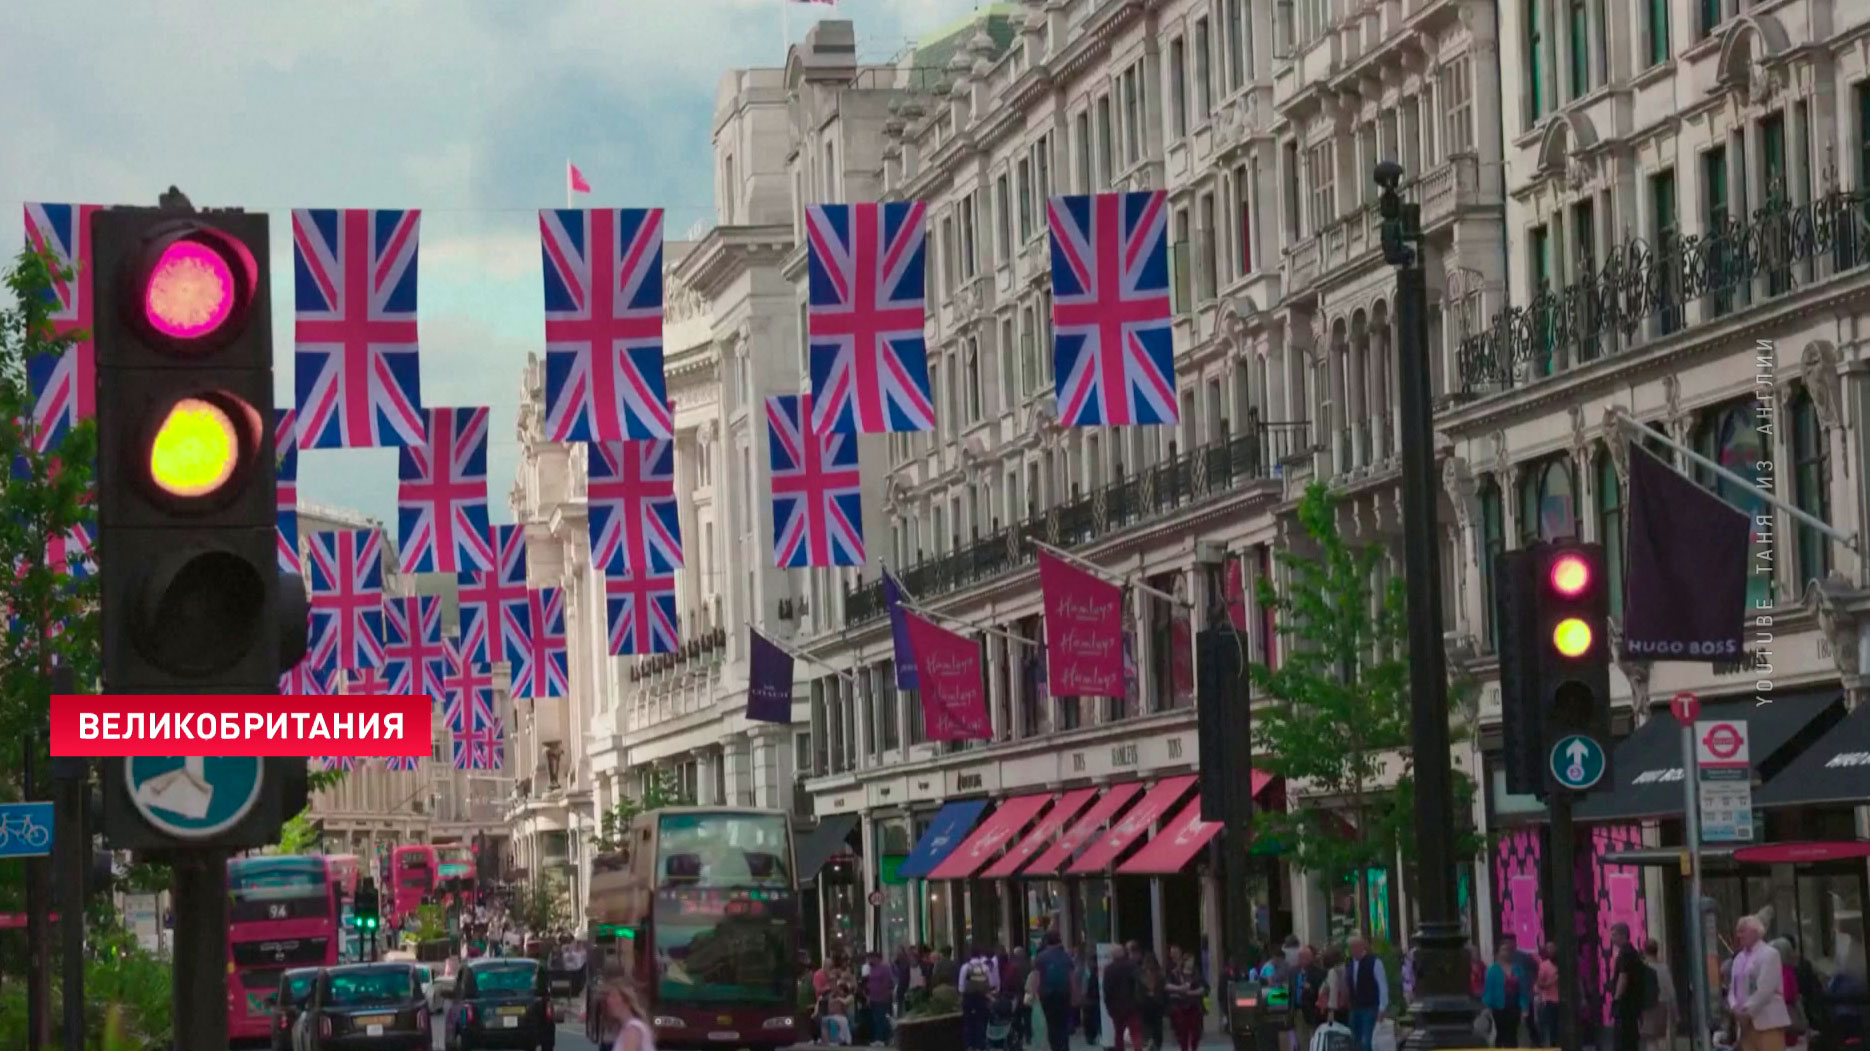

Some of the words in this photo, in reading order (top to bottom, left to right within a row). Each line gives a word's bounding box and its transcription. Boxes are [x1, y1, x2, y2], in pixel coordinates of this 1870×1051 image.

[1628, 640, 1683, 653] HUGO
[1689, 639, 1736, 654] BOSS
[1678, 697, 1693, 718] T
[269, 904, 287, 919] 94
